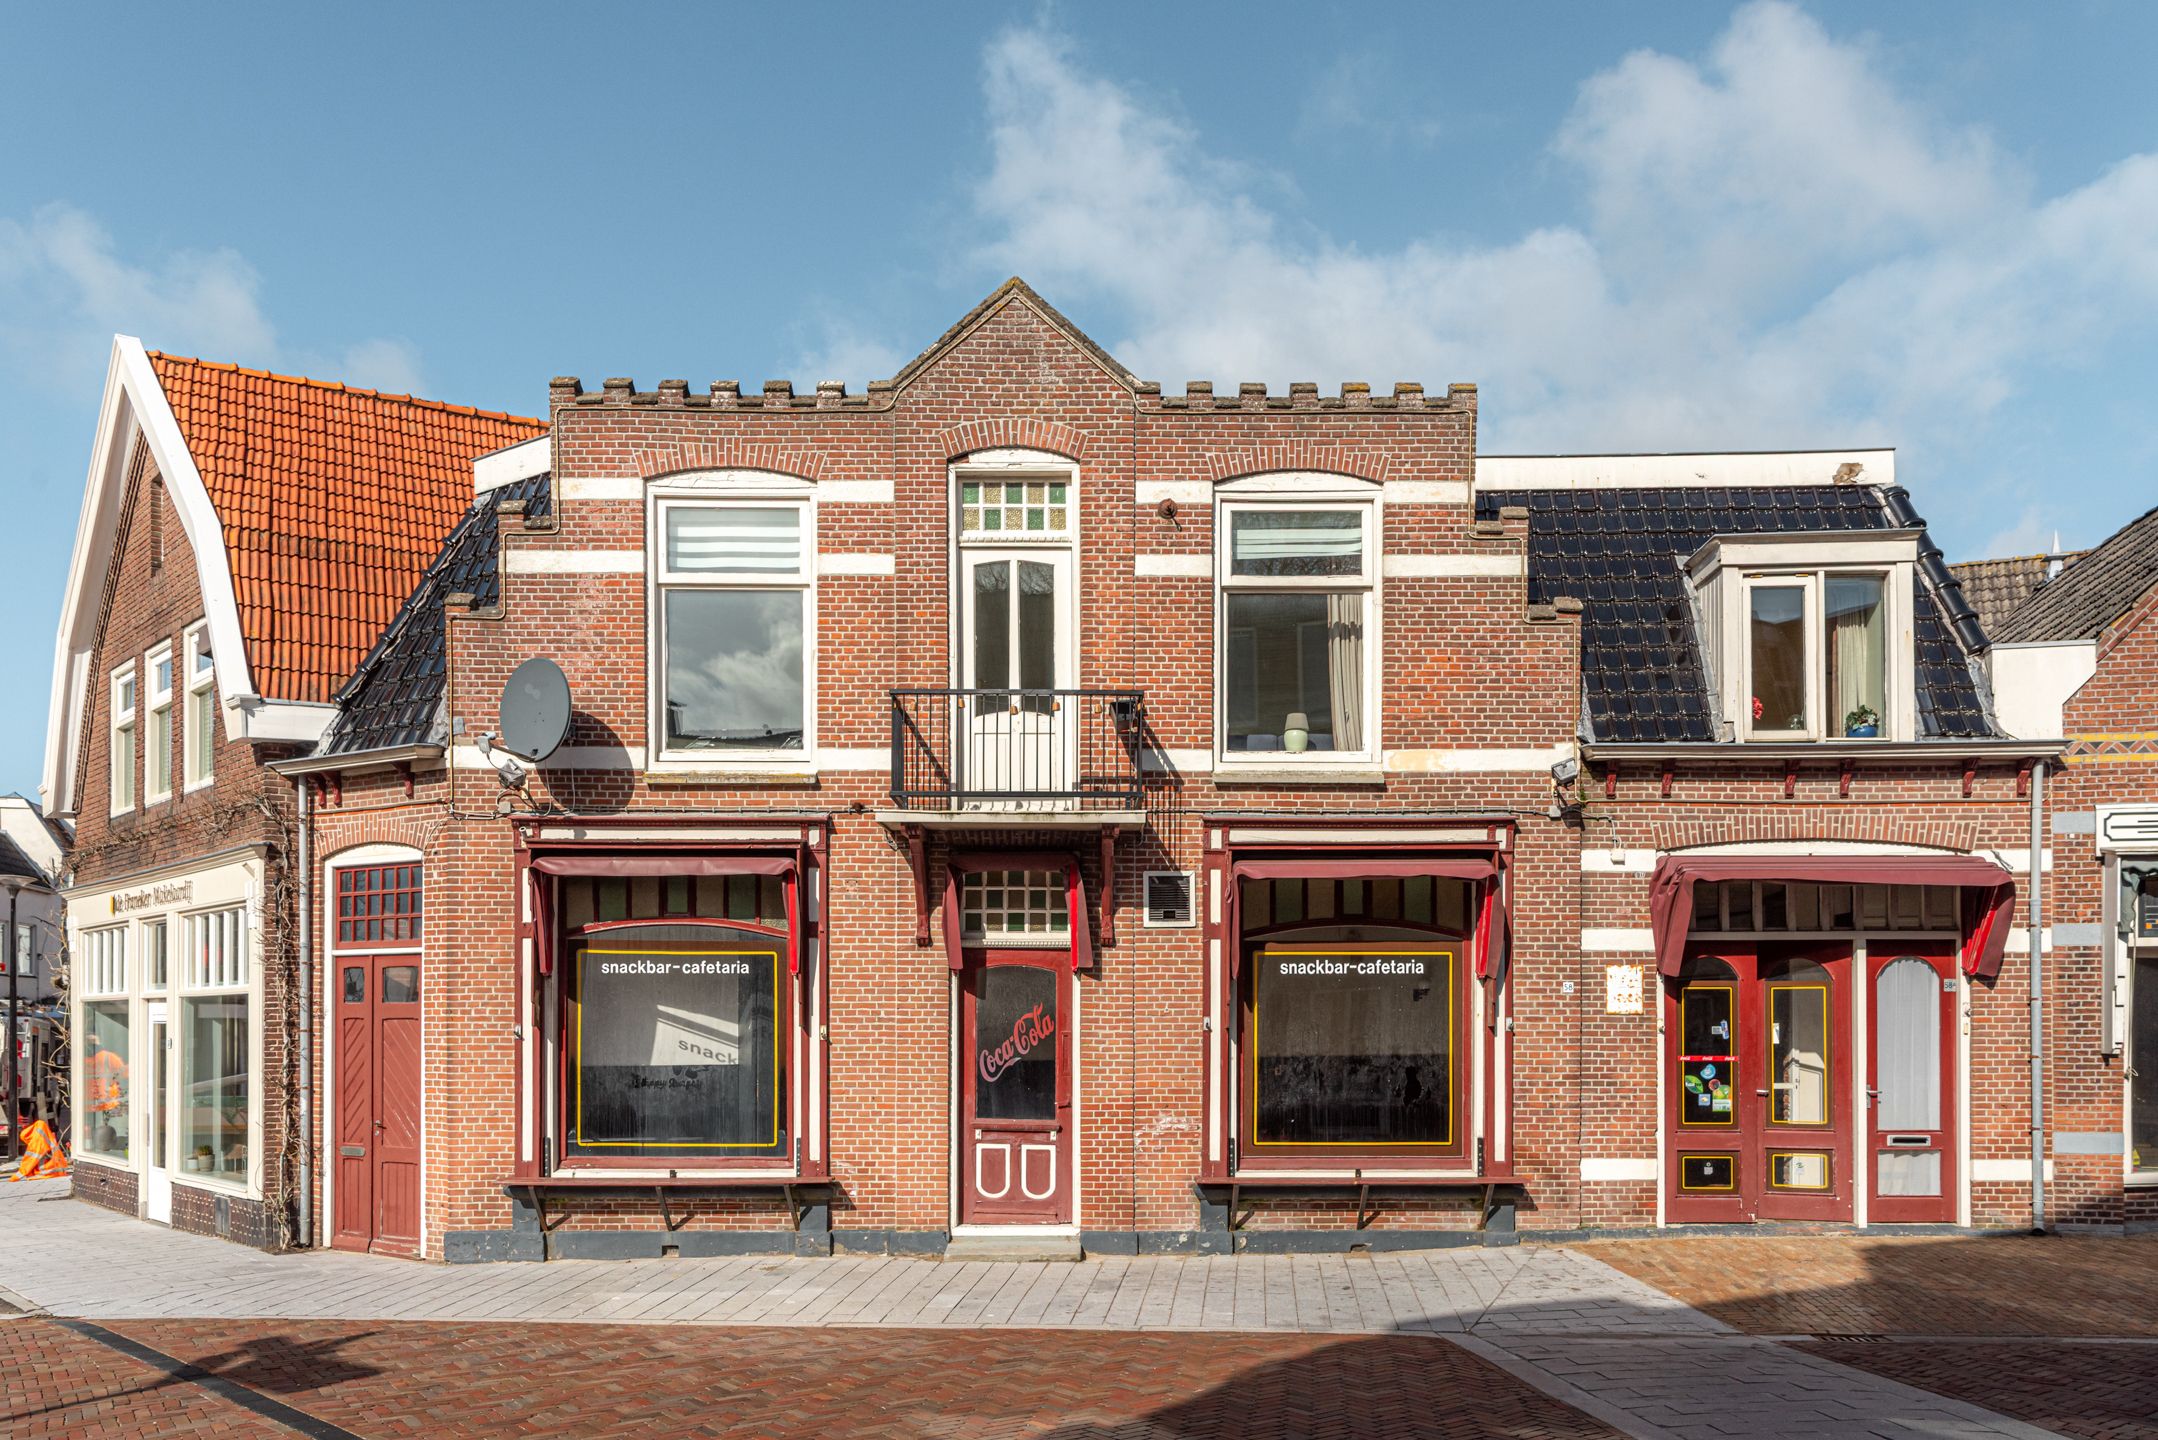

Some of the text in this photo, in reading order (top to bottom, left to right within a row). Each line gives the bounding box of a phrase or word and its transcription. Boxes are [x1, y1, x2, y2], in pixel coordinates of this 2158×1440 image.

[601, 960, 750, 974] snackbar-cafetaria
[1280, 959, 1424, 974] snackbar-cafetaria
[1564, 983, 1574, 991] 58
[979, 1002, 1055, 1082] Coca-Cola
[678, 1039, 738, 1065] snack
